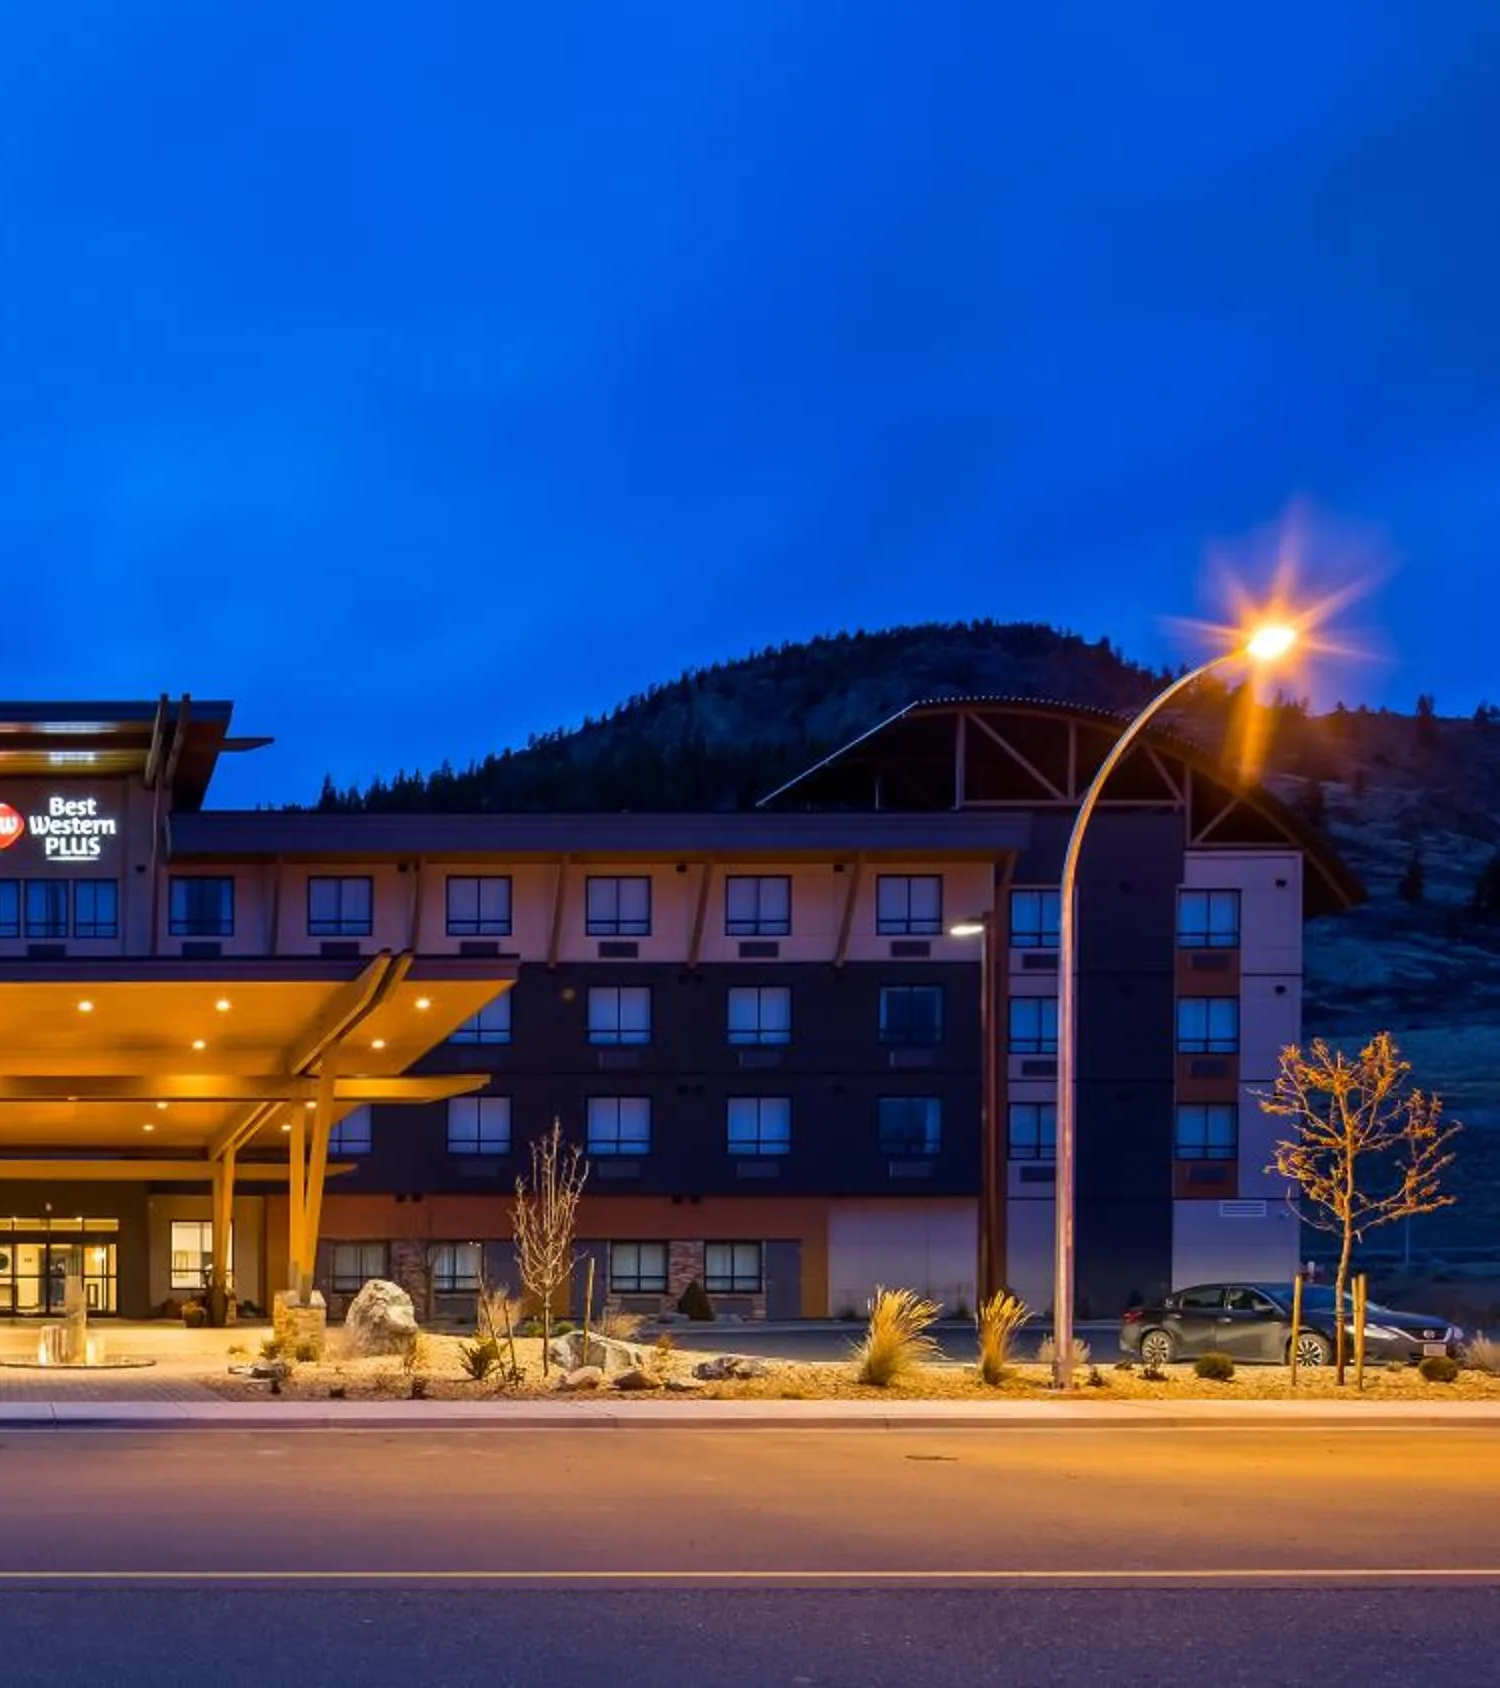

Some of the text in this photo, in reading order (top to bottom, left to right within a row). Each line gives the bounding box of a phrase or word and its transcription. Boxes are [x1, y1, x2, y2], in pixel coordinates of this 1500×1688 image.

[49, 797, 97, 816] Best
[28, 815, 117, 835] Western
[45, 836, 100, 855] PLUS
